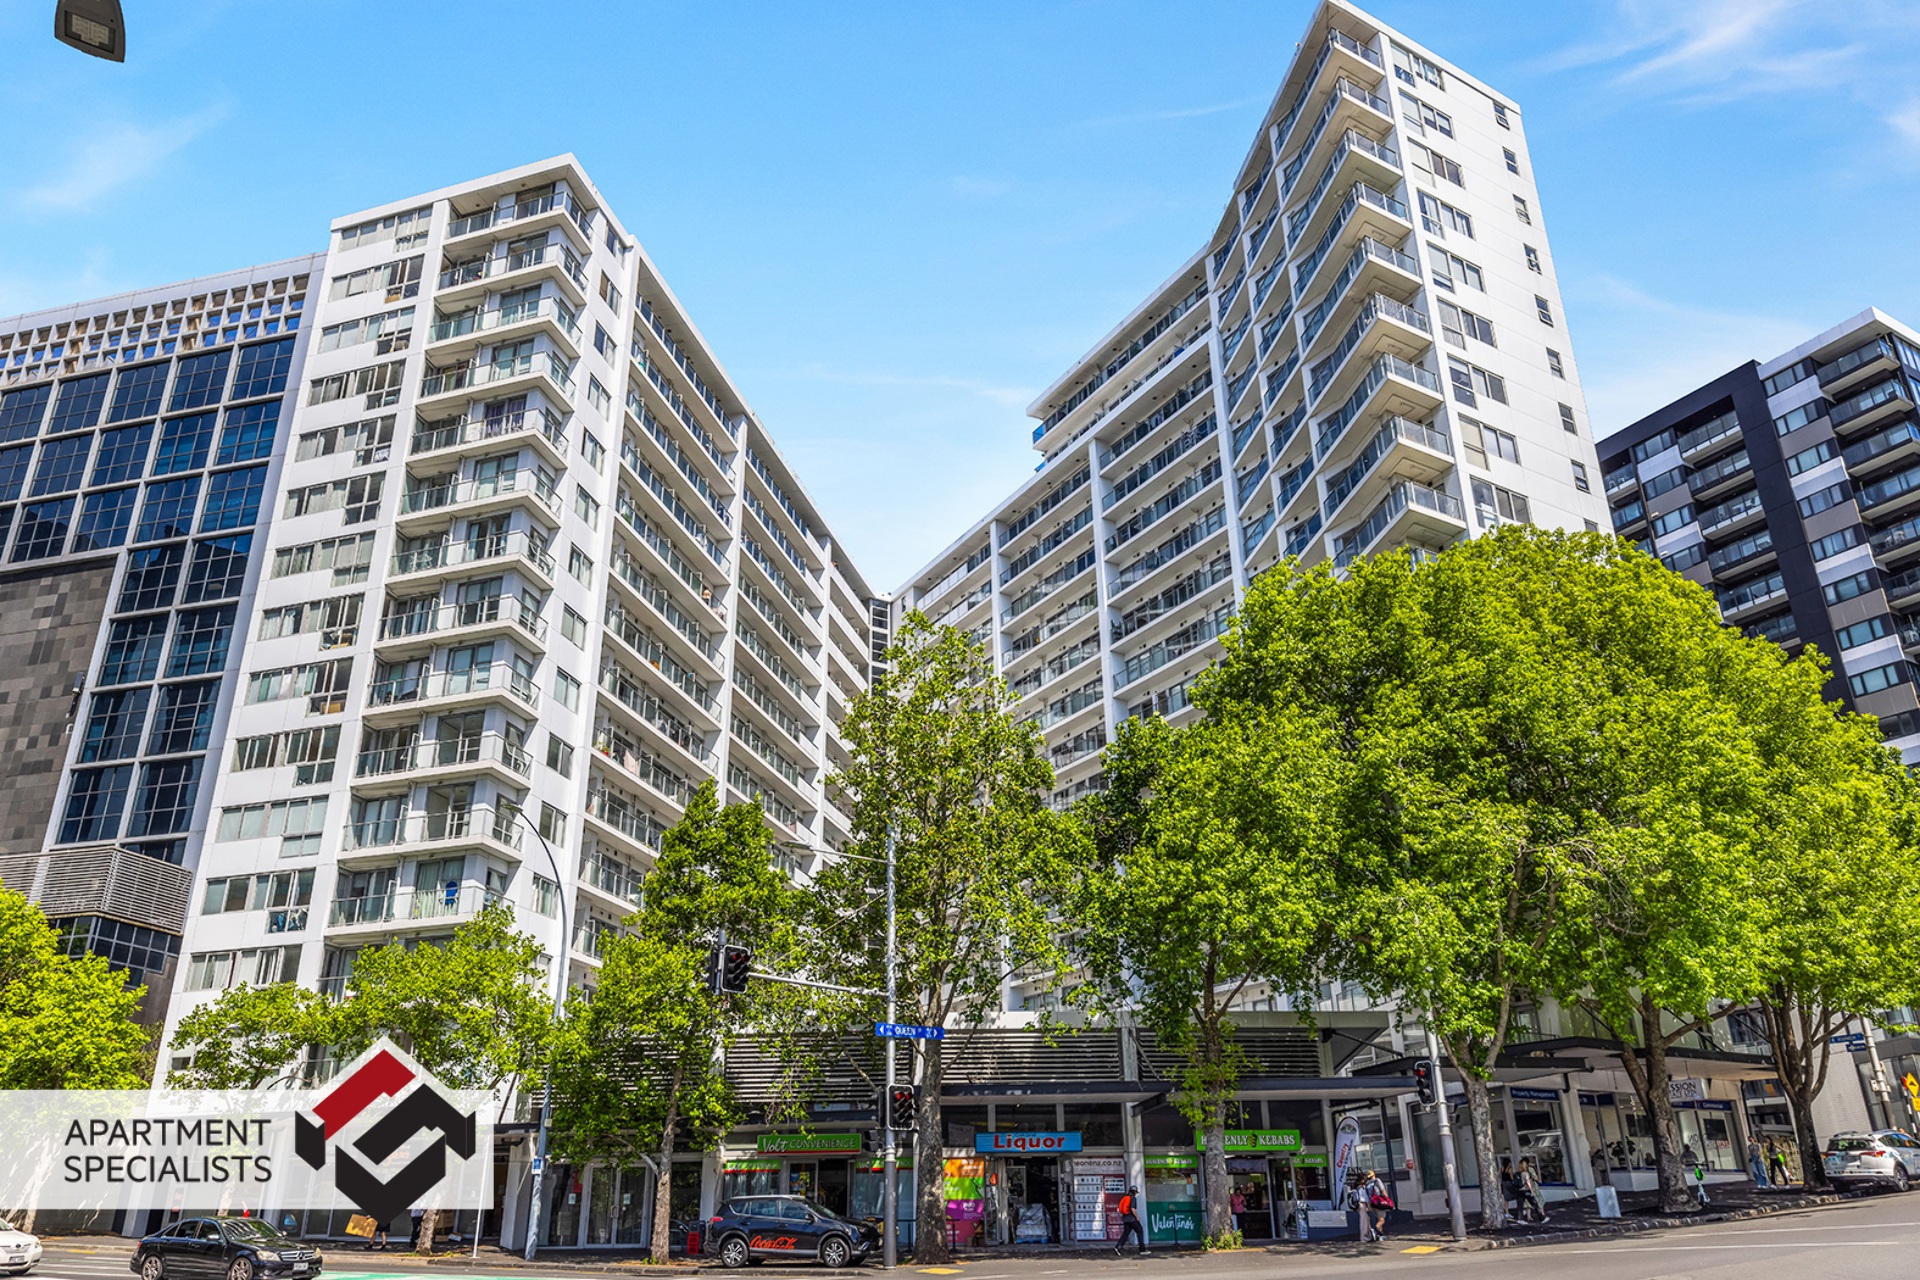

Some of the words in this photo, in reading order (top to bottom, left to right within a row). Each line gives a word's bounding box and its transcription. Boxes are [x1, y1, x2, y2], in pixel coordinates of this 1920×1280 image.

[894, 1025, 916, 1036] QUEEN
[1669, 1081, 1696, 1092] SSION
[762, 1138, 789, 1153] Volt
[789, 1139, 856, 1149] CONVENIENCE
[993, 1133, 1066, 1152] Liquor
[1201, 1135, 1249, 1146] HENLY
[1259, 1135, 1296, 1146] KEBABS
